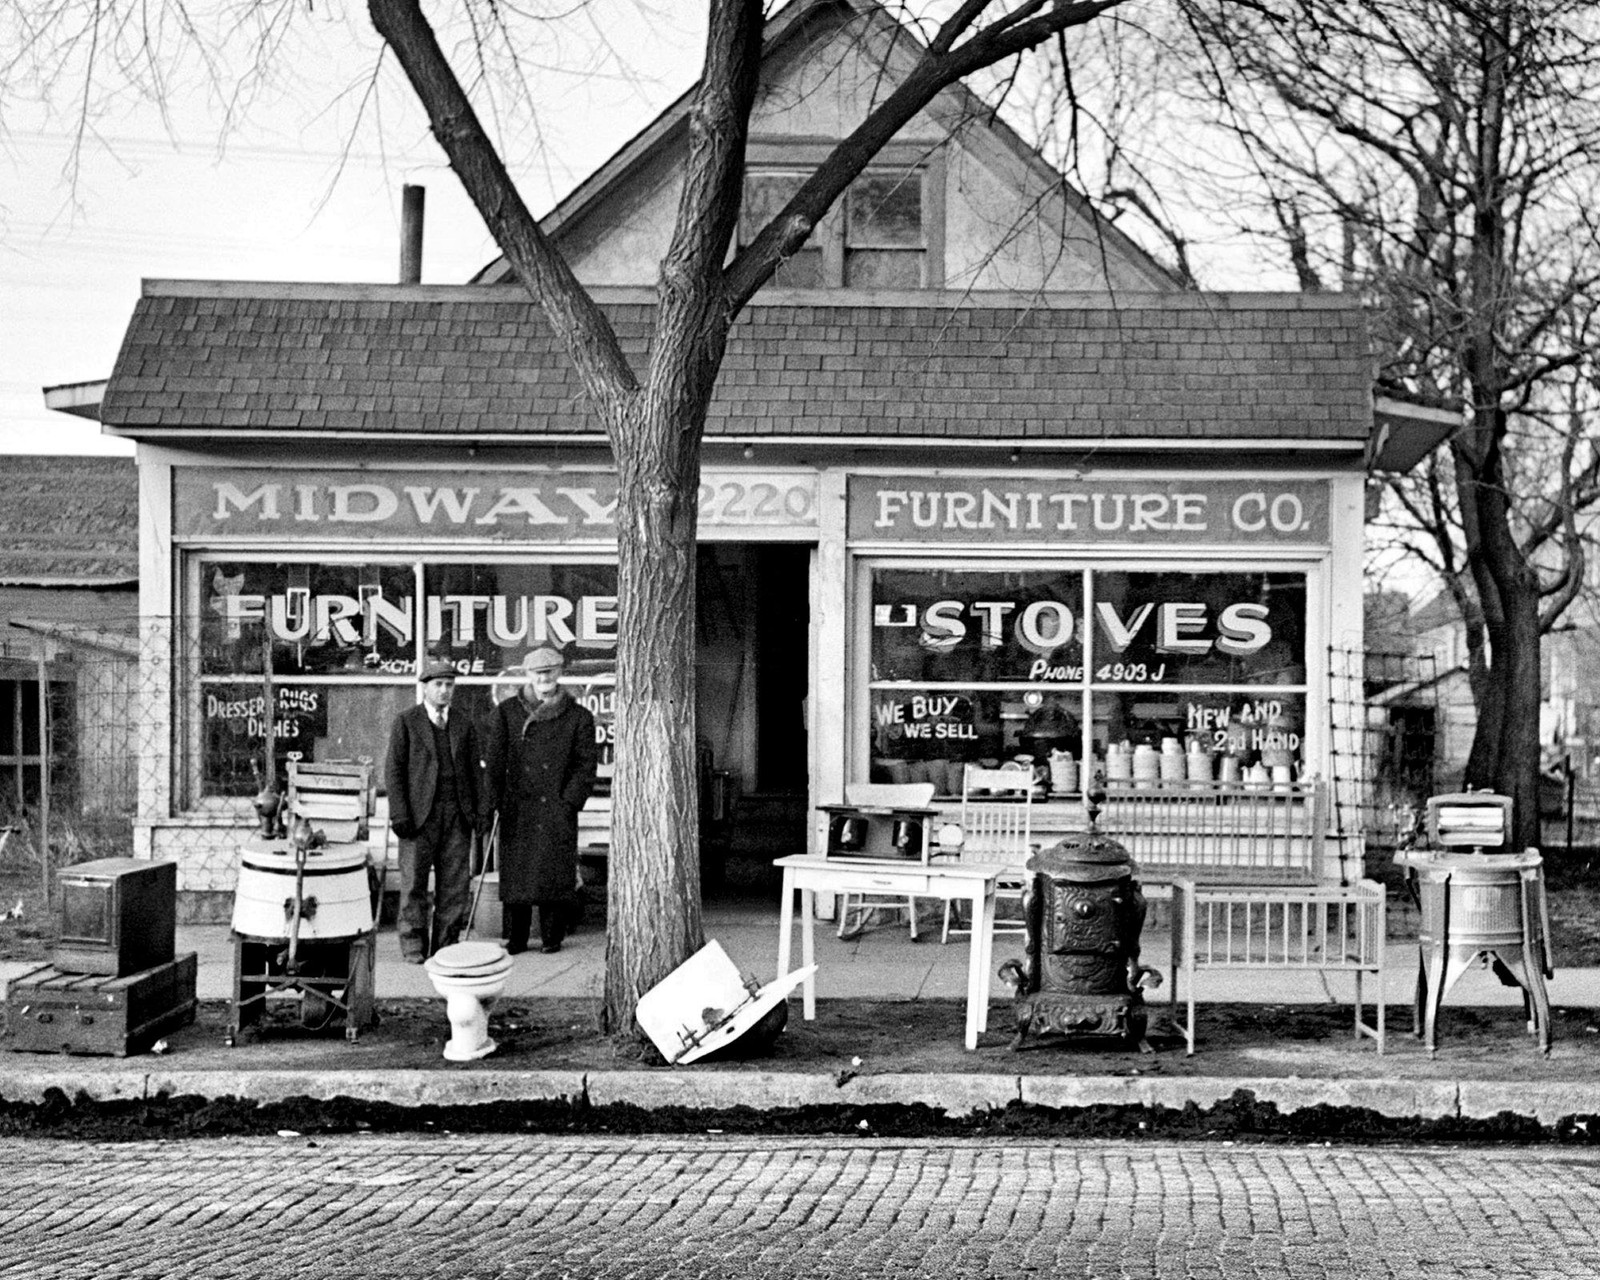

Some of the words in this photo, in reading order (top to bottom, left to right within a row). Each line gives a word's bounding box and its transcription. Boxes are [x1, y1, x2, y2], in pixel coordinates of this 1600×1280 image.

[212, 482, 618, 525] MIDWAY
[698, 483, 811, 518] 2220
[874, 489, 1208, 532] FURNITURE
[1232, 492, 1310, 532] CO.
[225, 594, 618, 646] FURNITURE
[921, 600, 1272, 654] STOVES
[1029, 659, 1083, 681] PHONE
[1096, 663, 1147, 681] 4903
[1151, 663, 1166, 681] J
[280, 688, 318, 712] RUGS
[876, 700, 905, 726] WE
[912, 695, 958, 719] BUY
[1187, 701, 1231, 729] NEW
[1241, 700, 1281, 723] AND
[904, 723, 932, 739] WE
[935, 723, 978, 739] SELL
[1252, 728, 1299, 751] HAND
